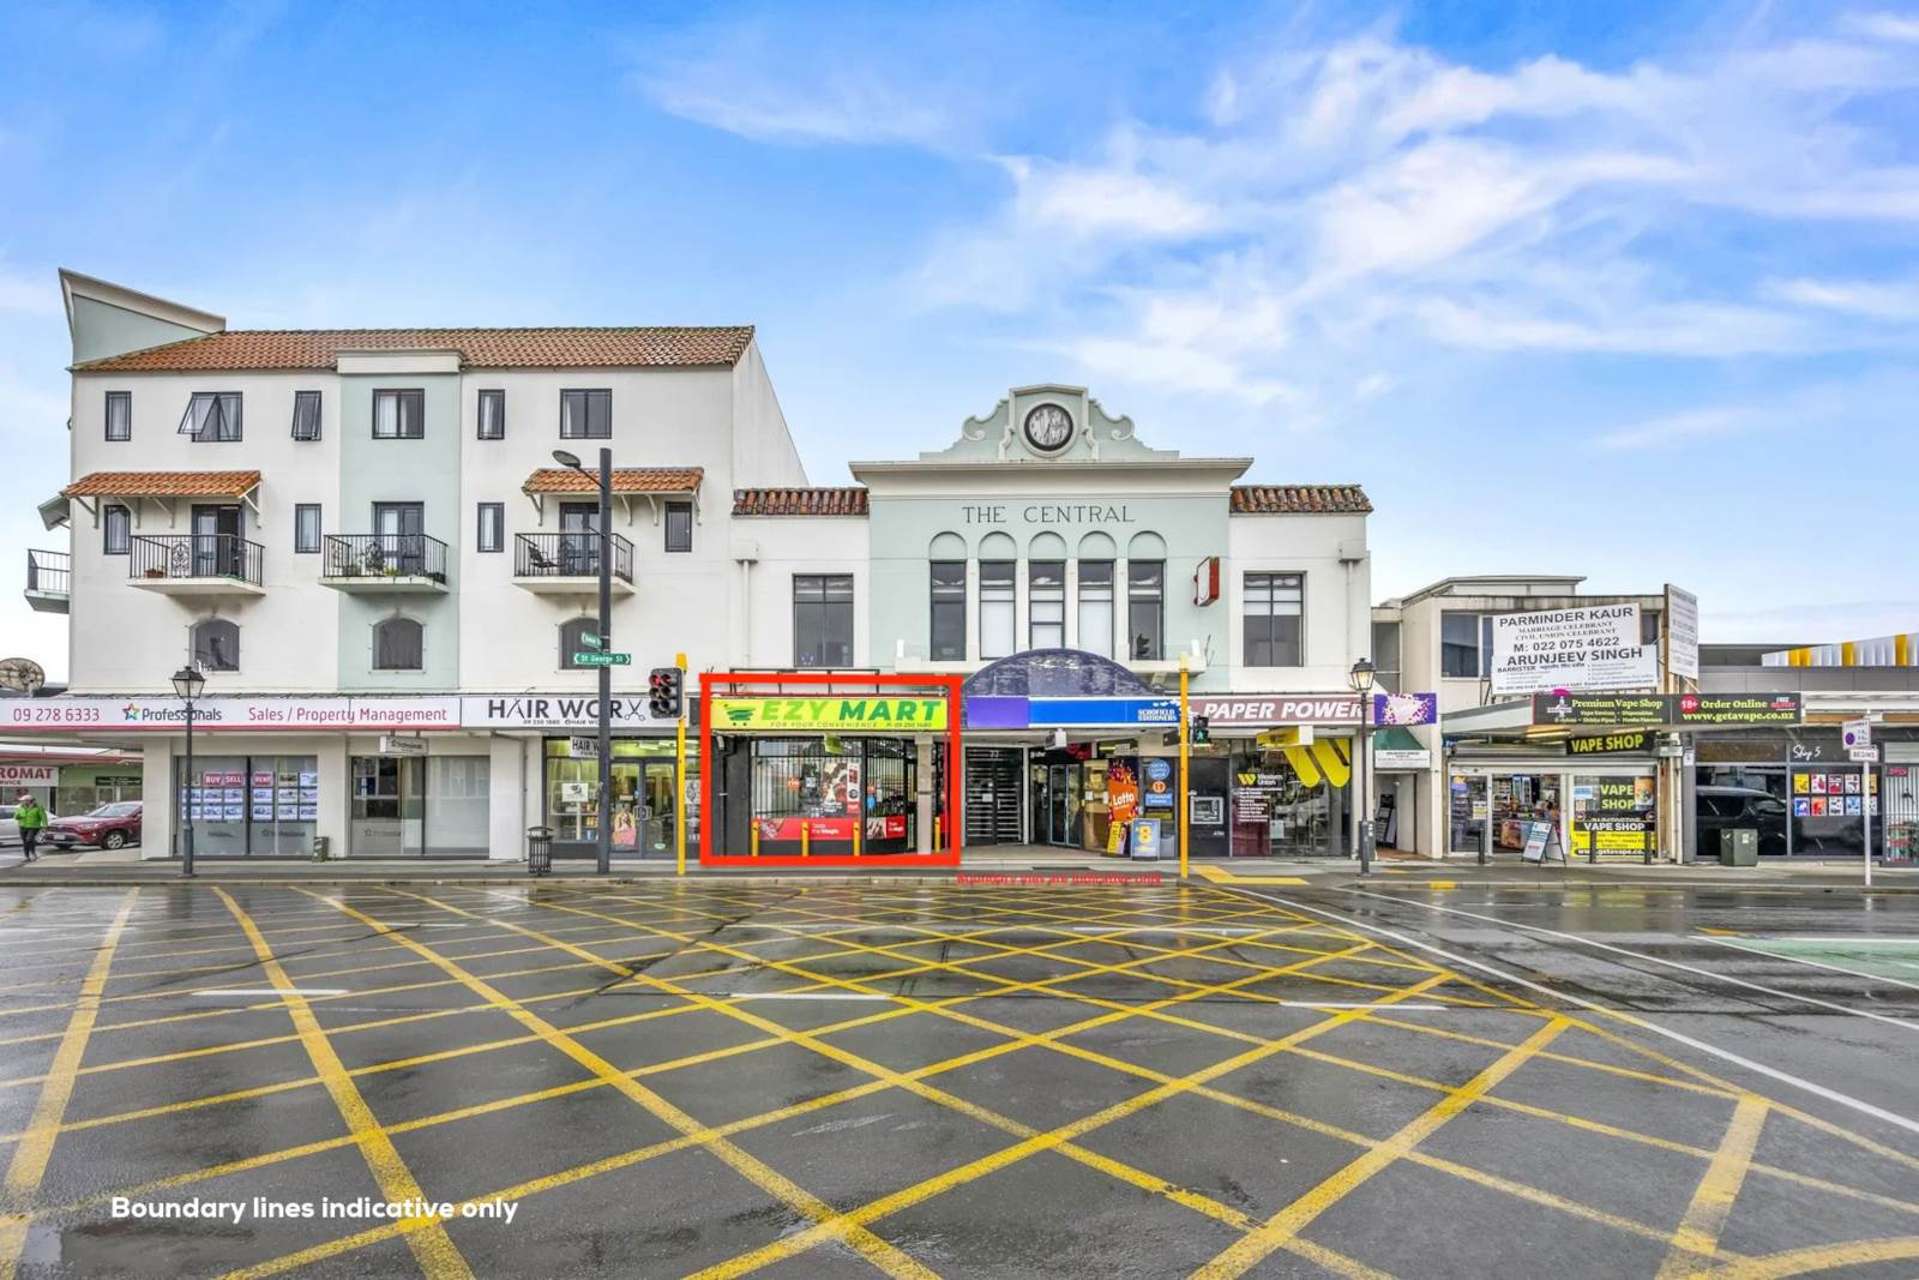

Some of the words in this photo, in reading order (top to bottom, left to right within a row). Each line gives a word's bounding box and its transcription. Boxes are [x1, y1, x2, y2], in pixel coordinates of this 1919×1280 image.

[962, 506, 1007, 523] THE
[1023, 505, 1136, 523] CENTRAL
[1499, 611, 1585, 628] PARMINDER
[1589, 607, 1633, 619] KAUR
[1513, 643, 1528, 652] M:
[1533, 641, 1555, 651] 022
[1560, 639, 1583, 649] 075
[1587, 636, 1620, 647] 4622
[1507, 650, 1587, 666] ARUNJEEV
[1591, 647, 1643, 660] SINGH
[488, 699, 549, 718] HAIR
[761, 700, 831, 720] EZY
[838, 700, 941, 721] MART
[1203, 702, 1276, 719] PAPER
[1281, 702, 1364, 719] POWER
[1572, 699, 1615, 707] Premium
[1615, 699, 1638, 709] Vape
[1639, 699, 1663, 709] Shop
[1681, 700, 1698, 709] 18+
[1701, 700, 1731, 708] Order
[1733, 699, 1768, 708] Online
[13, 708, 31, 721] 09
[36, 708, 61, 721] 278
[65, 708, 100, 721] 6333
[142, 707, 222, 720] Professonals
[248, 707, 284, 721] Sales
[287, 707, 293, 721] /
[296, 708, 354, 723] Property
[359, 708, 447, 723] Management
[1682, 712, 1795, 722] www.getavape.co.nz
[572, 739, 590, 750] HAIR
[1571, 738, 1603, 752] VAPE
[1605, 735, 1644, 750] SHOP
[1600, 784, 1634, 795] VAPE
[1112, 791, 1135, 806] Lotto
[1601, 798, 1635, 809] SHOP
[1584, 822, 1613, 831] VAPE
[1615, 822, 1645, 831] SHOP
